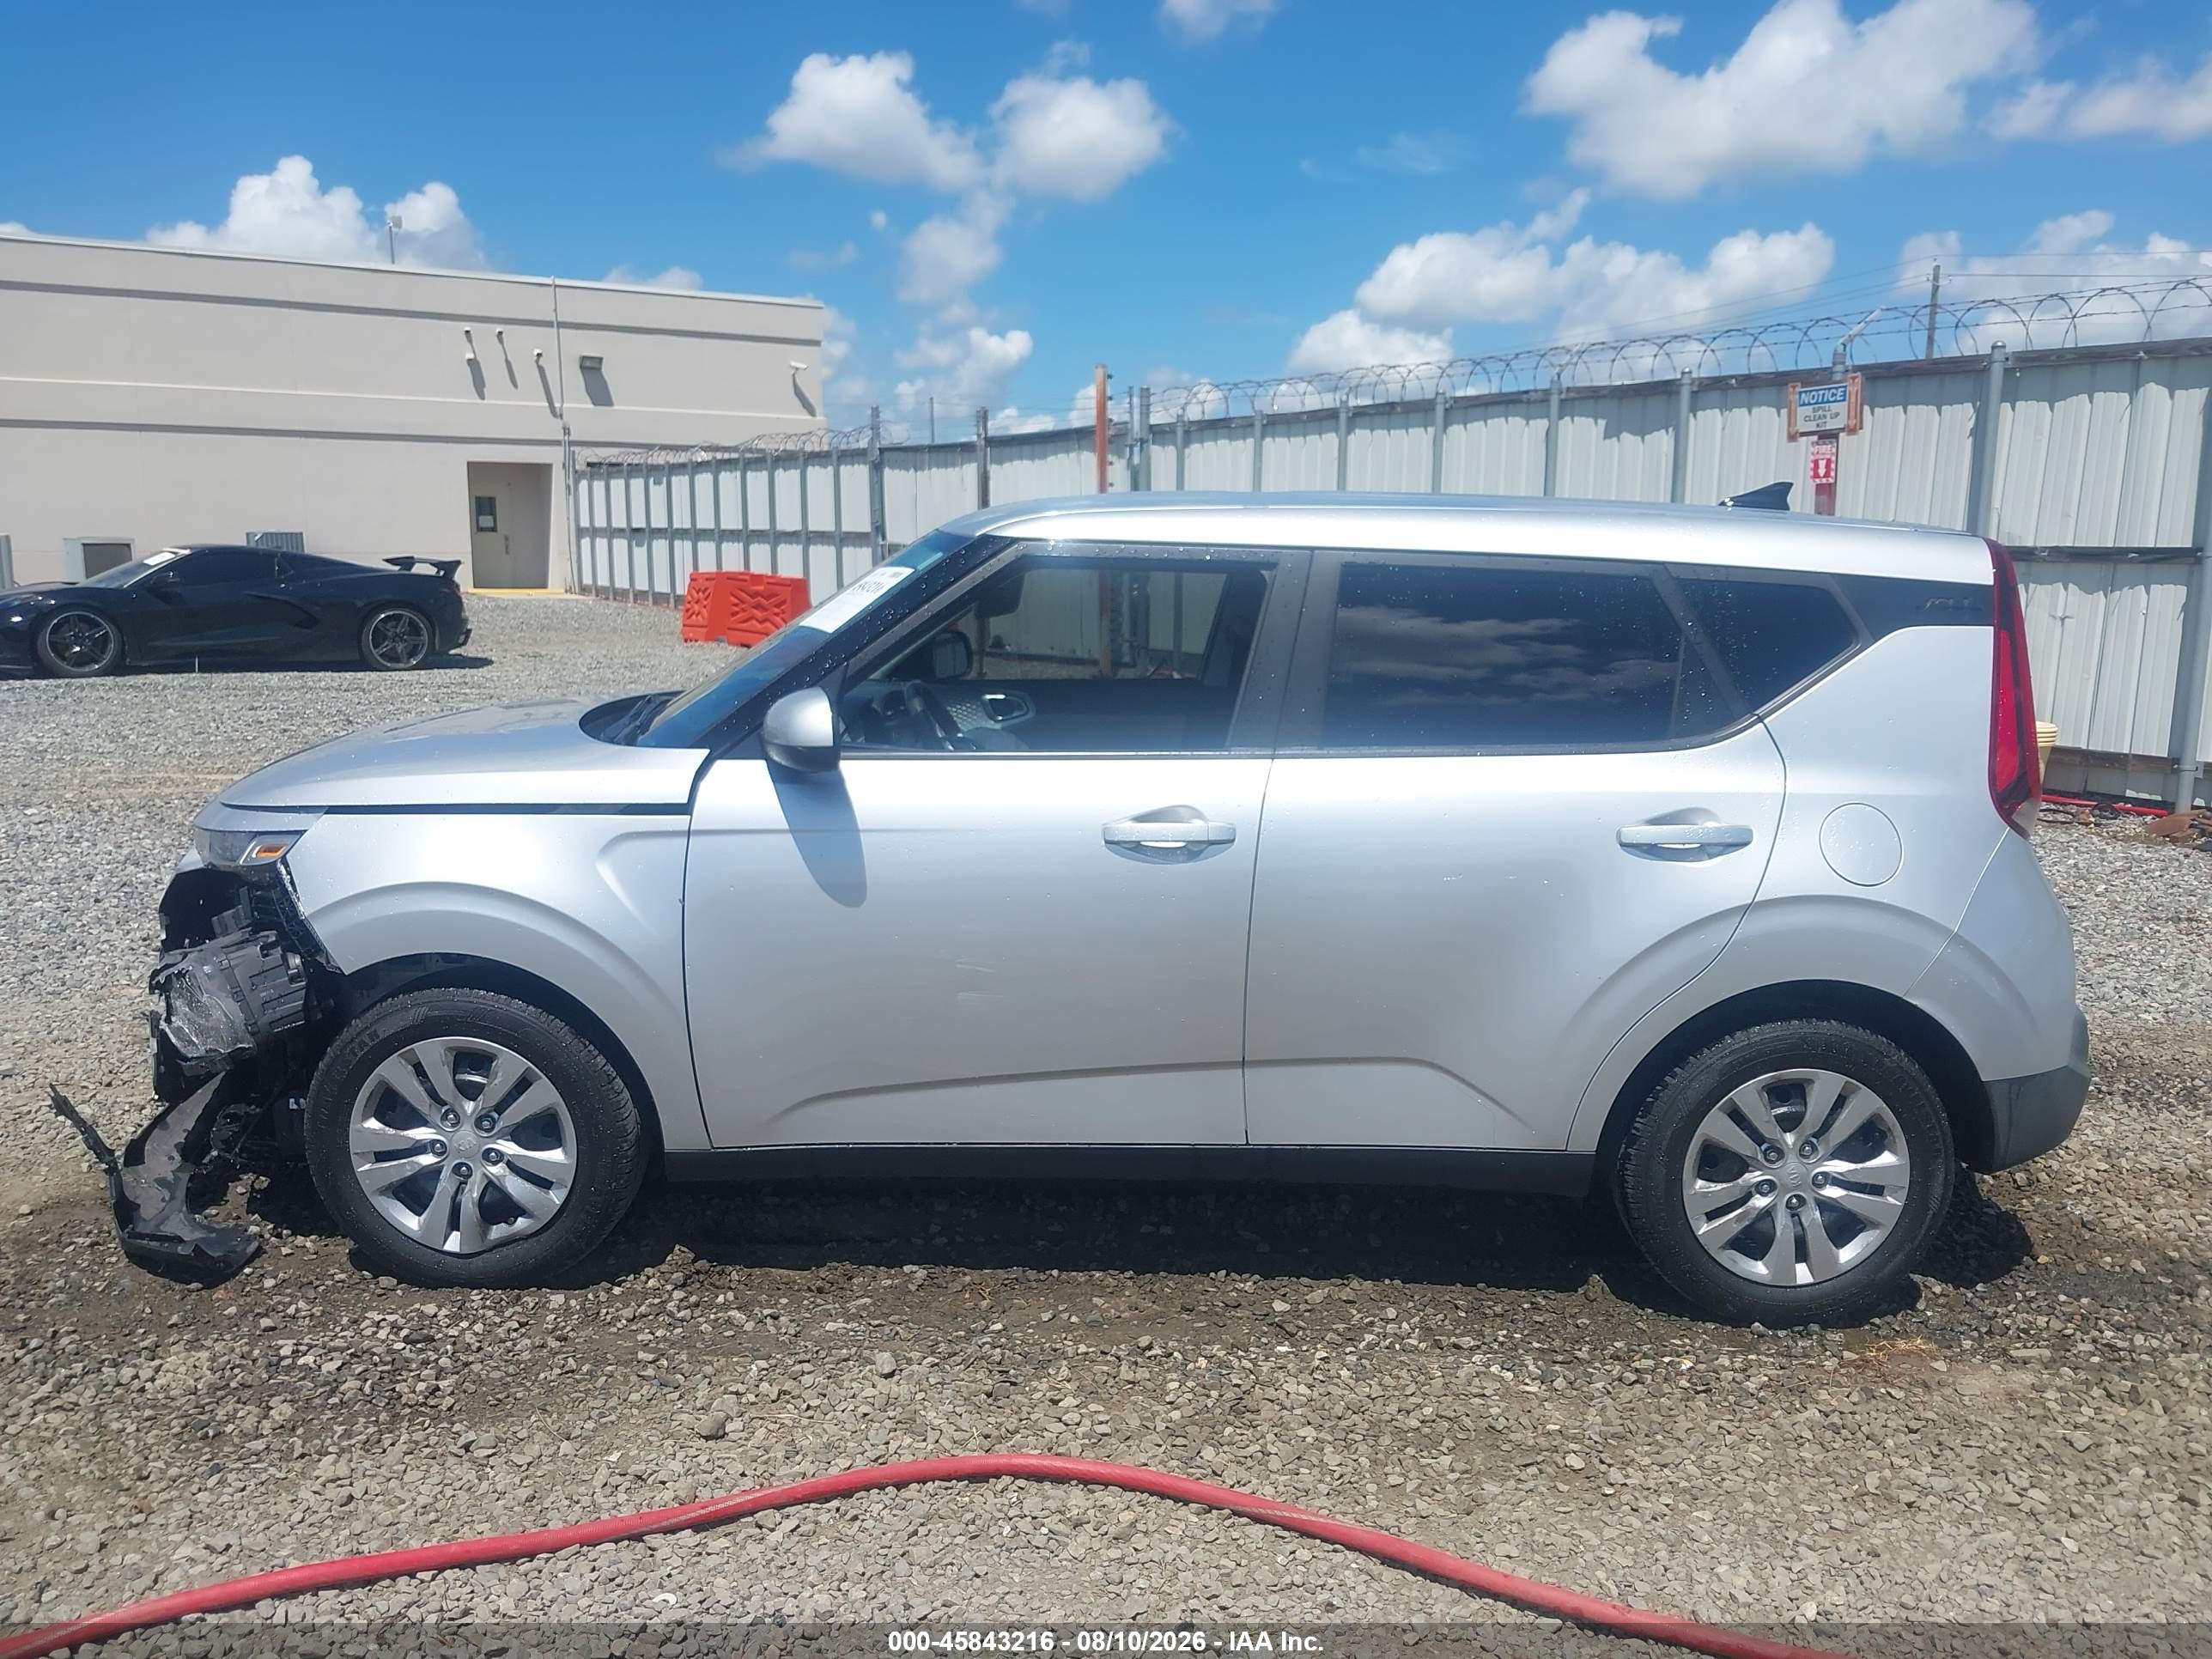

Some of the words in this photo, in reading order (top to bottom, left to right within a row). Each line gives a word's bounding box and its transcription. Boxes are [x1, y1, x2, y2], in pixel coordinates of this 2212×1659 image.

[1800, 387, 1844, 404] NOTICE
[1803, 413, 1827, 422] CLEAN
[1829, 411, 1840, 420] UP
